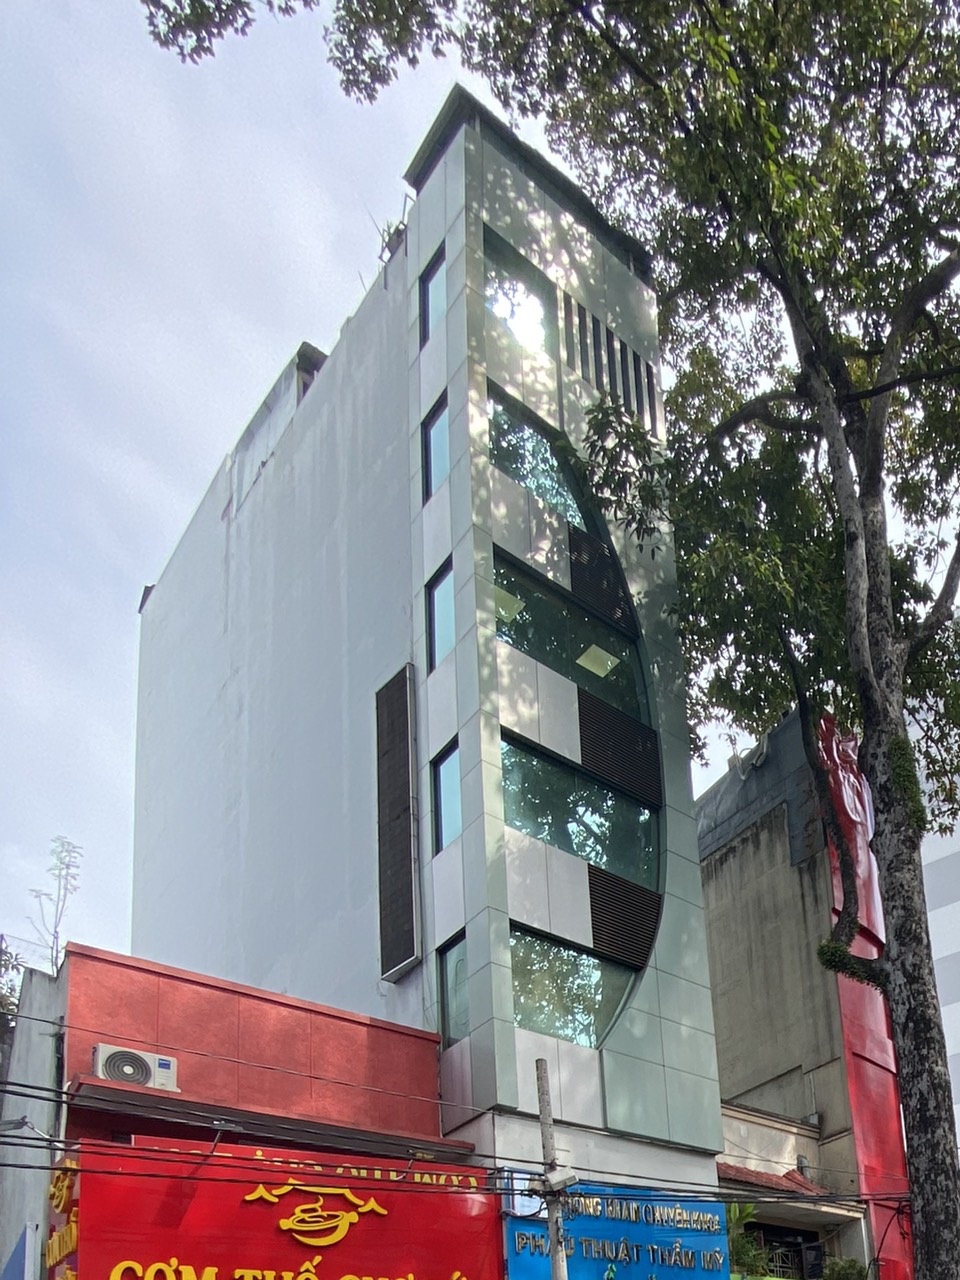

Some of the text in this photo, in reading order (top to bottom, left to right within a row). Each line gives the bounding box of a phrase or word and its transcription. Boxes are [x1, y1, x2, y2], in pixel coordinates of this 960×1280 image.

[515, 1230, 725, 1270] PHU THUẬT THẨM MỸ
